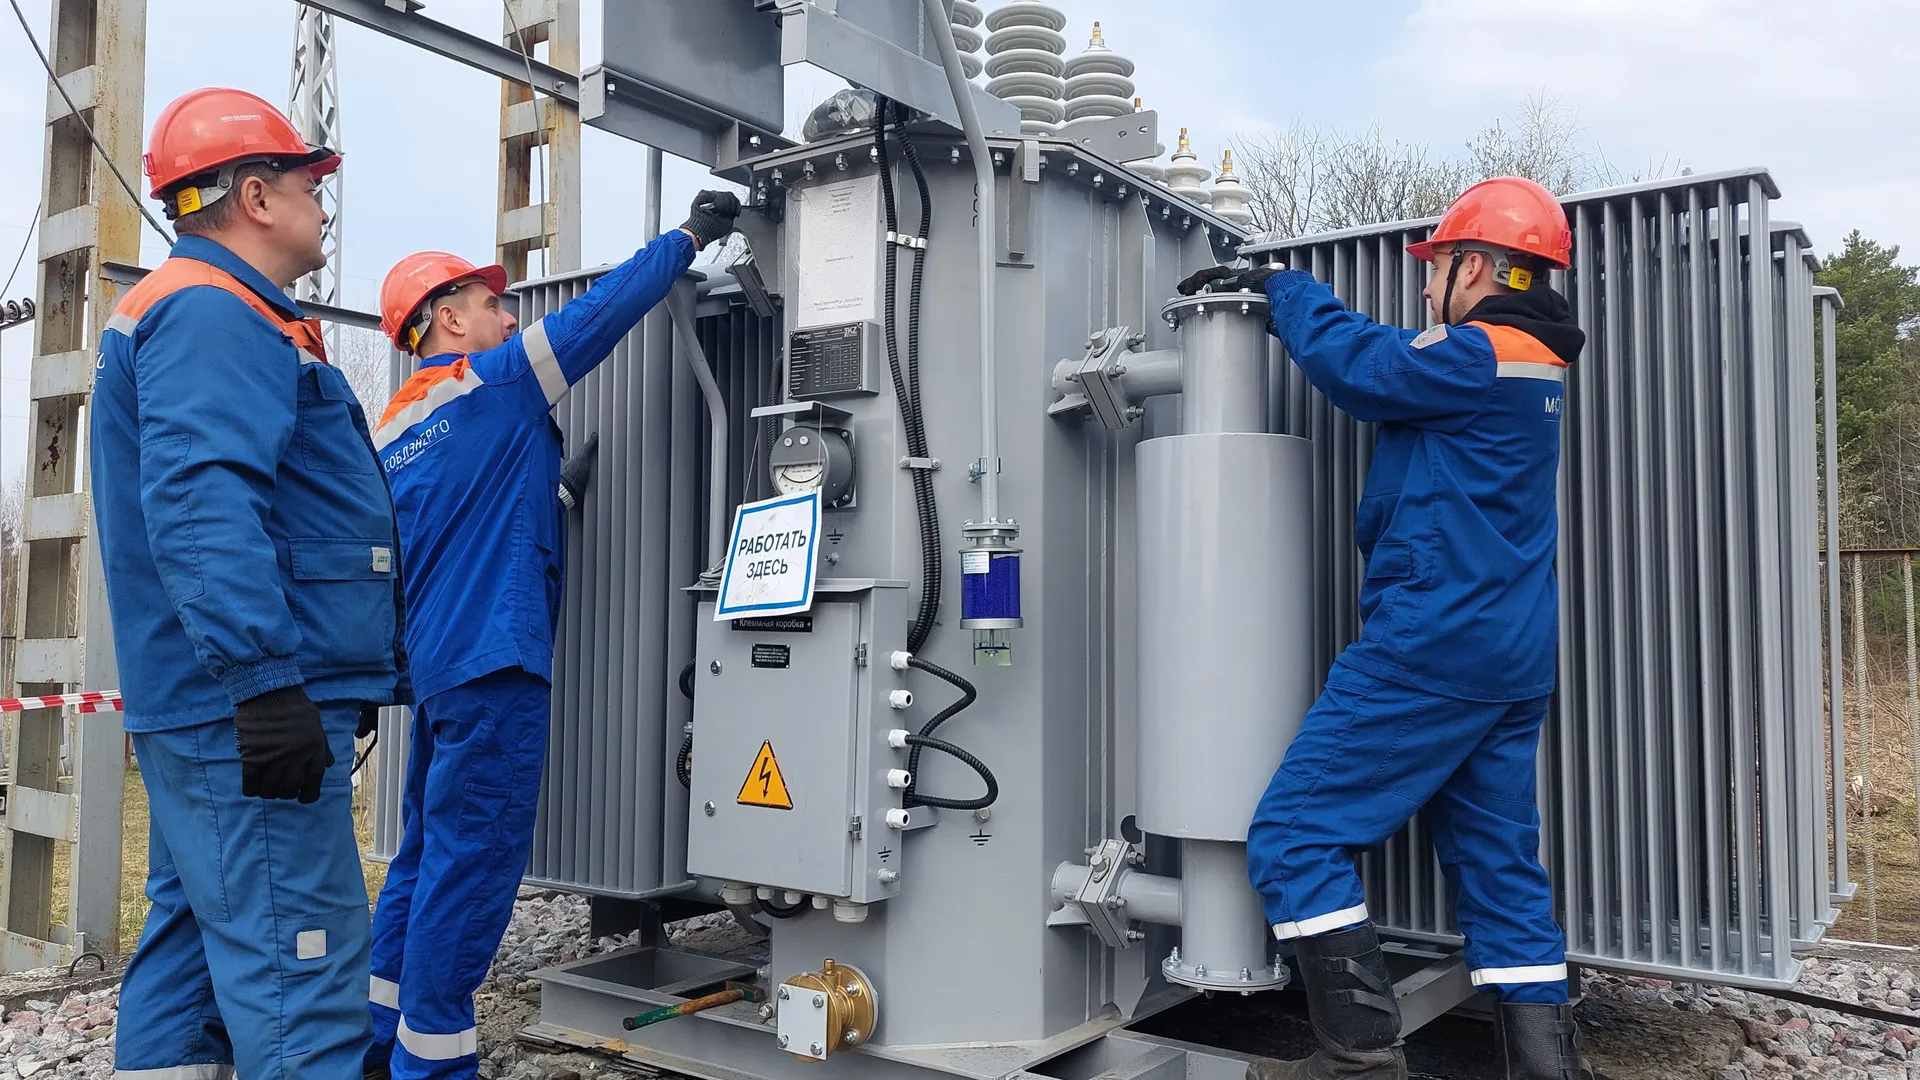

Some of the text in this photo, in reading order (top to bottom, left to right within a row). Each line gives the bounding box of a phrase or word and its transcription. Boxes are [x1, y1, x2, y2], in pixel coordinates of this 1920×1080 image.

[738, 529, 807, 557] РАБОТАТЬ
[746, 558, 788, 580] ЗДЕСЬ
[739, 618, 805, 630] Клеммная коробка
